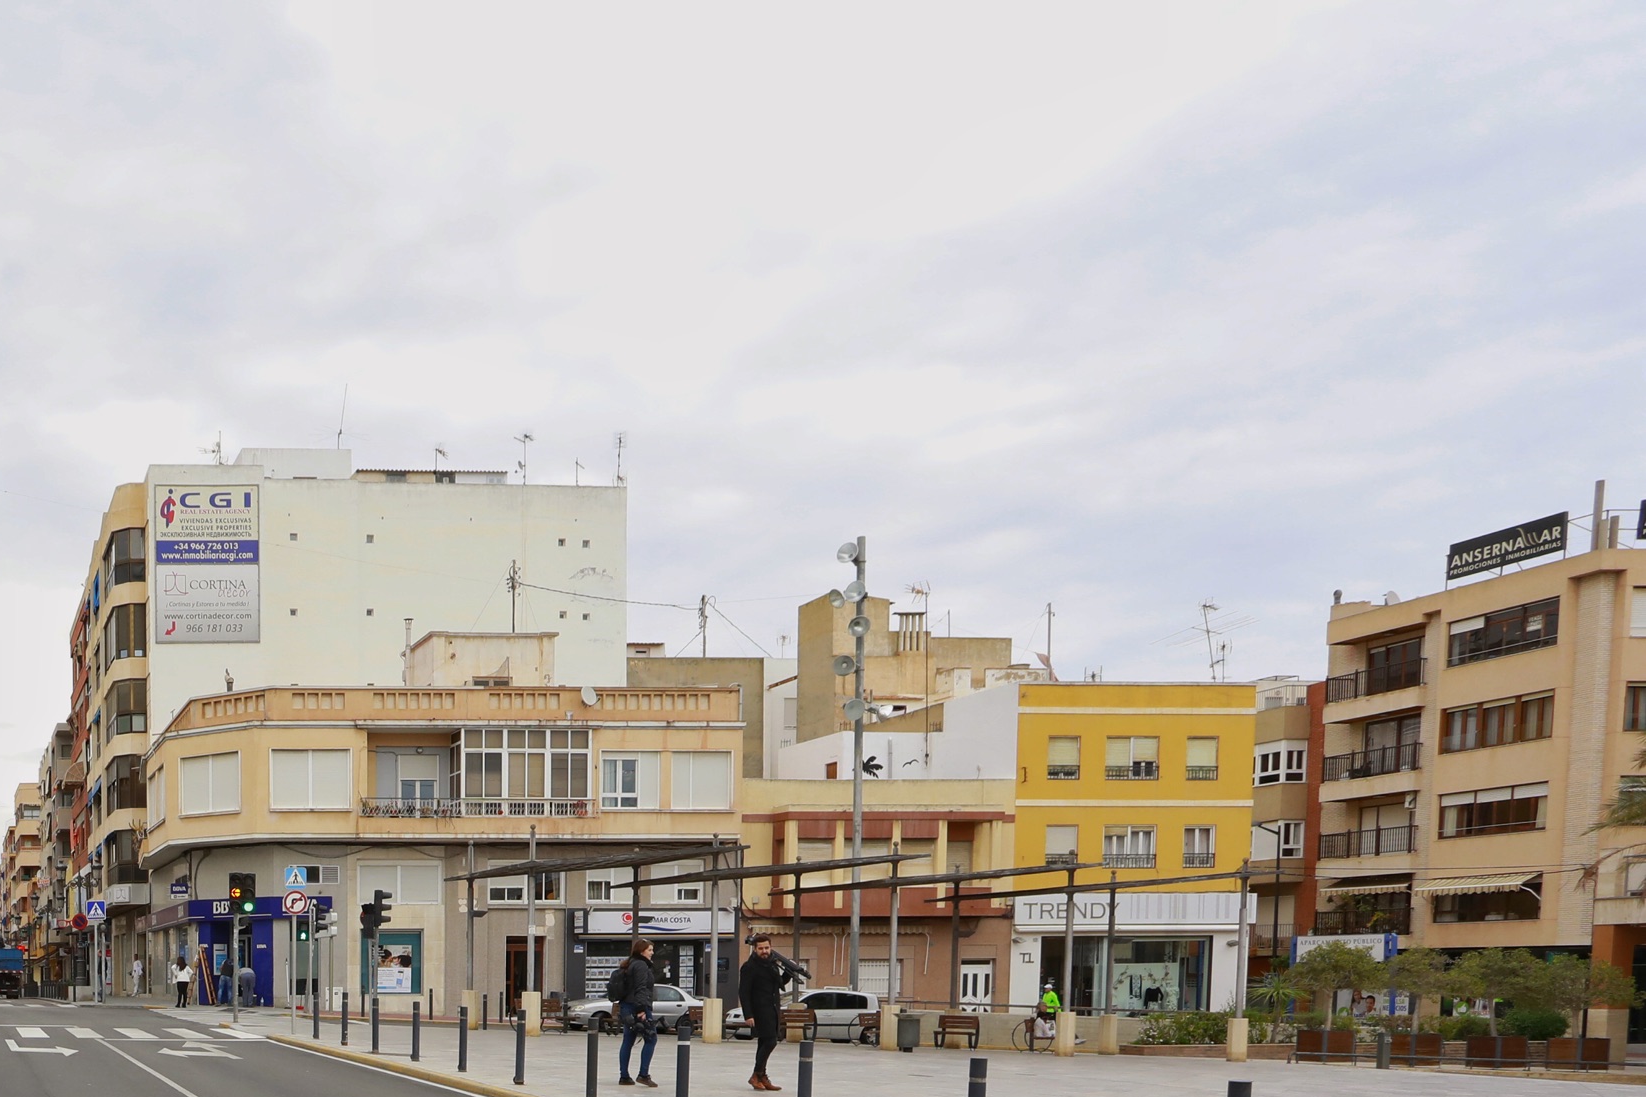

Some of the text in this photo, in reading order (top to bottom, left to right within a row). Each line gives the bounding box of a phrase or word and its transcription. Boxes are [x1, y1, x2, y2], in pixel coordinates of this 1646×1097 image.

[180, 492, 251, 508] CGI
[161, 550, 254, 561] www.inmobiliariacgi.com
[1450, 540, 1562, 576] PROMOCIONES INMOBILIARIAS
[189, 580, 246, 590] CORTINA
[186, 624, 244, 632] 966 181 033
